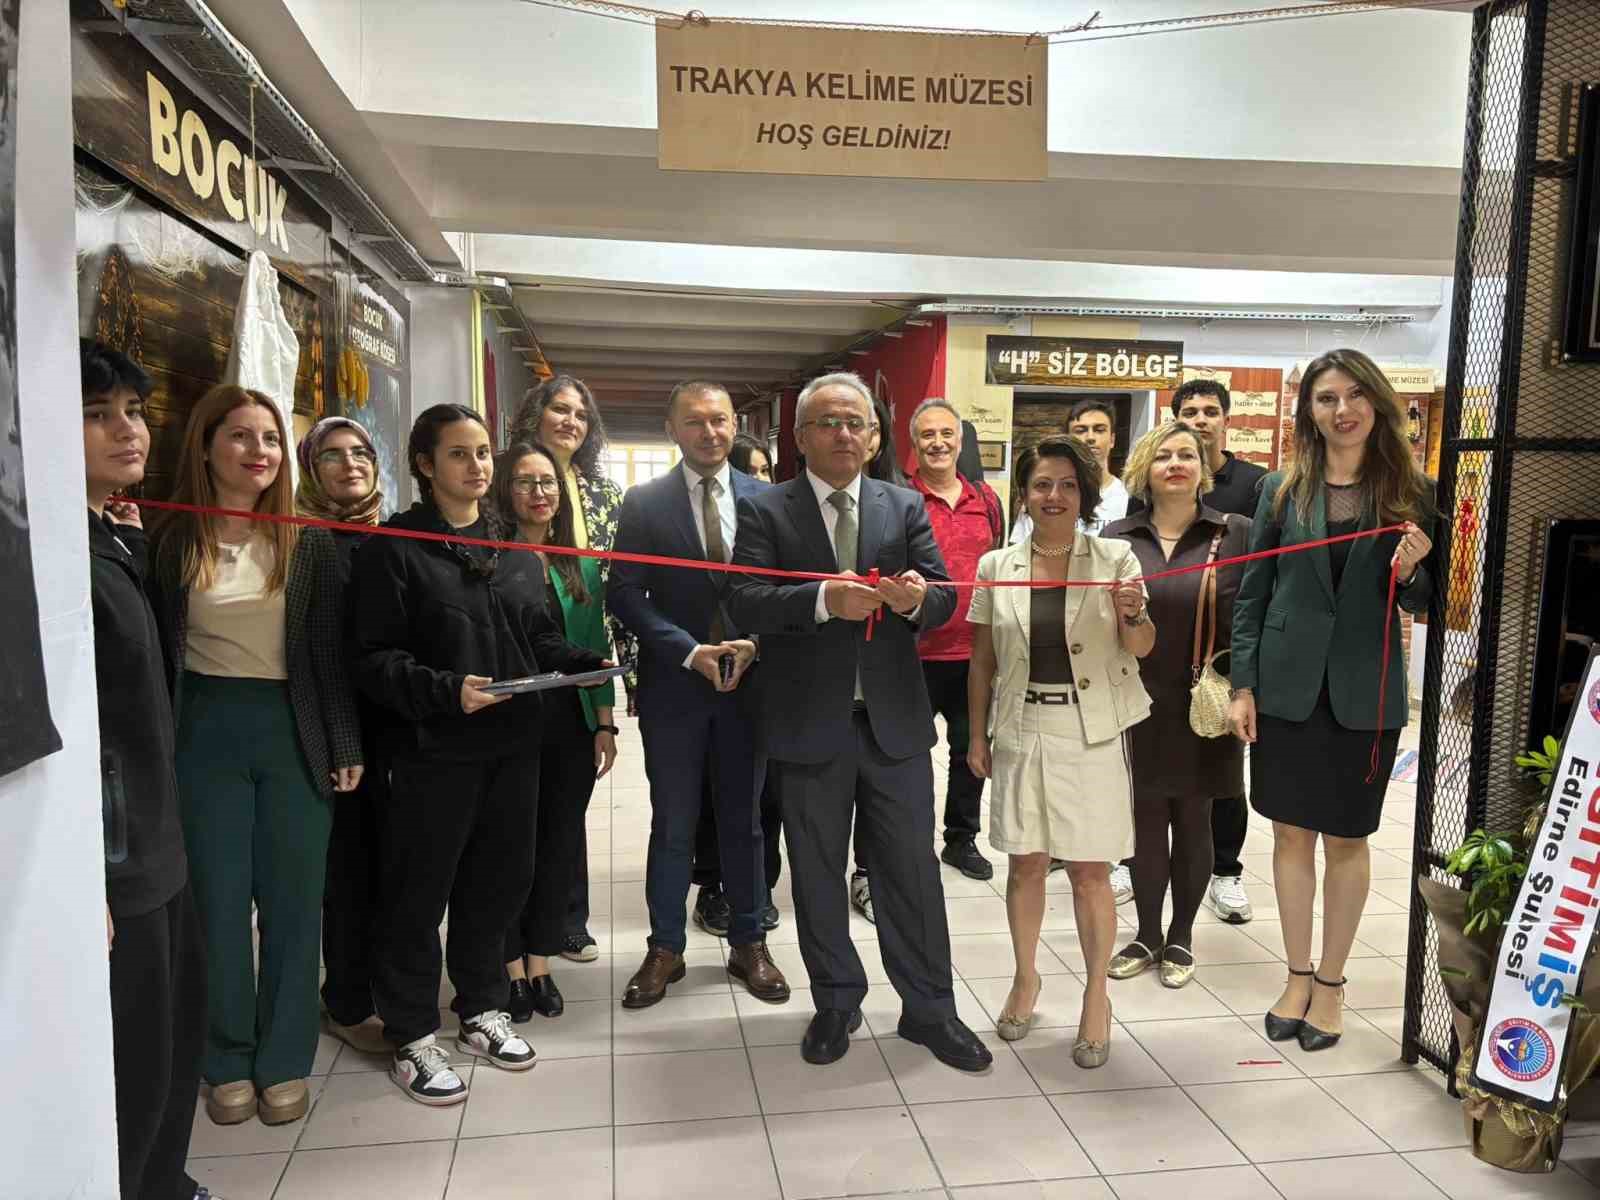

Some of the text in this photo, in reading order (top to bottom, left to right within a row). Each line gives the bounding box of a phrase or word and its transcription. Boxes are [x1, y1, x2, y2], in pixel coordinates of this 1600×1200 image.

[669, 65, 1033, 106] TRAKYA KELİME MÜZESİ
[146, 71, 289, 253] BOCUK
[756, 122, 951, 150] HOŞ GELDİNİZ!
[1047, 347, 1088, 376] SİZ
[1096, 349, 1179, 378] BÖLGE
[1542, 756, 1589, 862] Edirne
[1505, 871, 1554, 980] Şubesi
